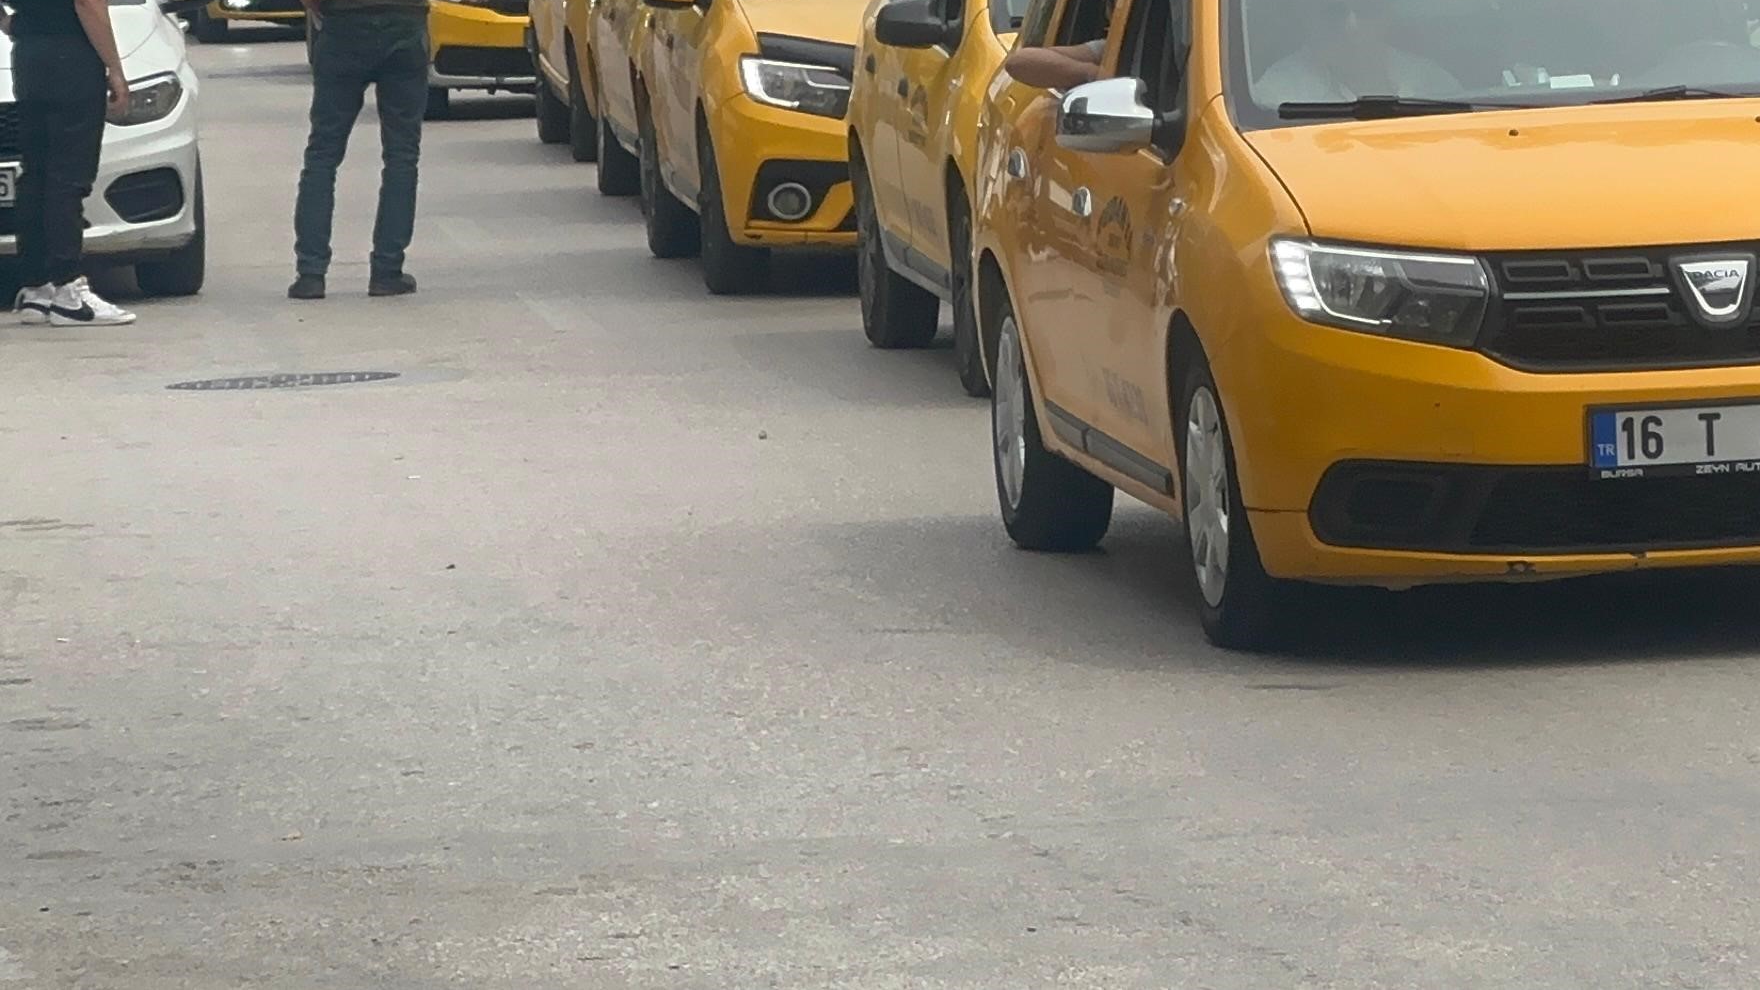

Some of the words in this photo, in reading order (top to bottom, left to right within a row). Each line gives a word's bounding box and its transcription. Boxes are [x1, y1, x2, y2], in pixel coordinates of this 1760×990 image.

[1693, 269, 1740, 280] DACIA
[1598, 443, 1615, 456] TR
[1622, 415, 1663, 460] 16
[1698, 412, 1721, 456] T
[1696, 463, 1730, 475] ZEYN
